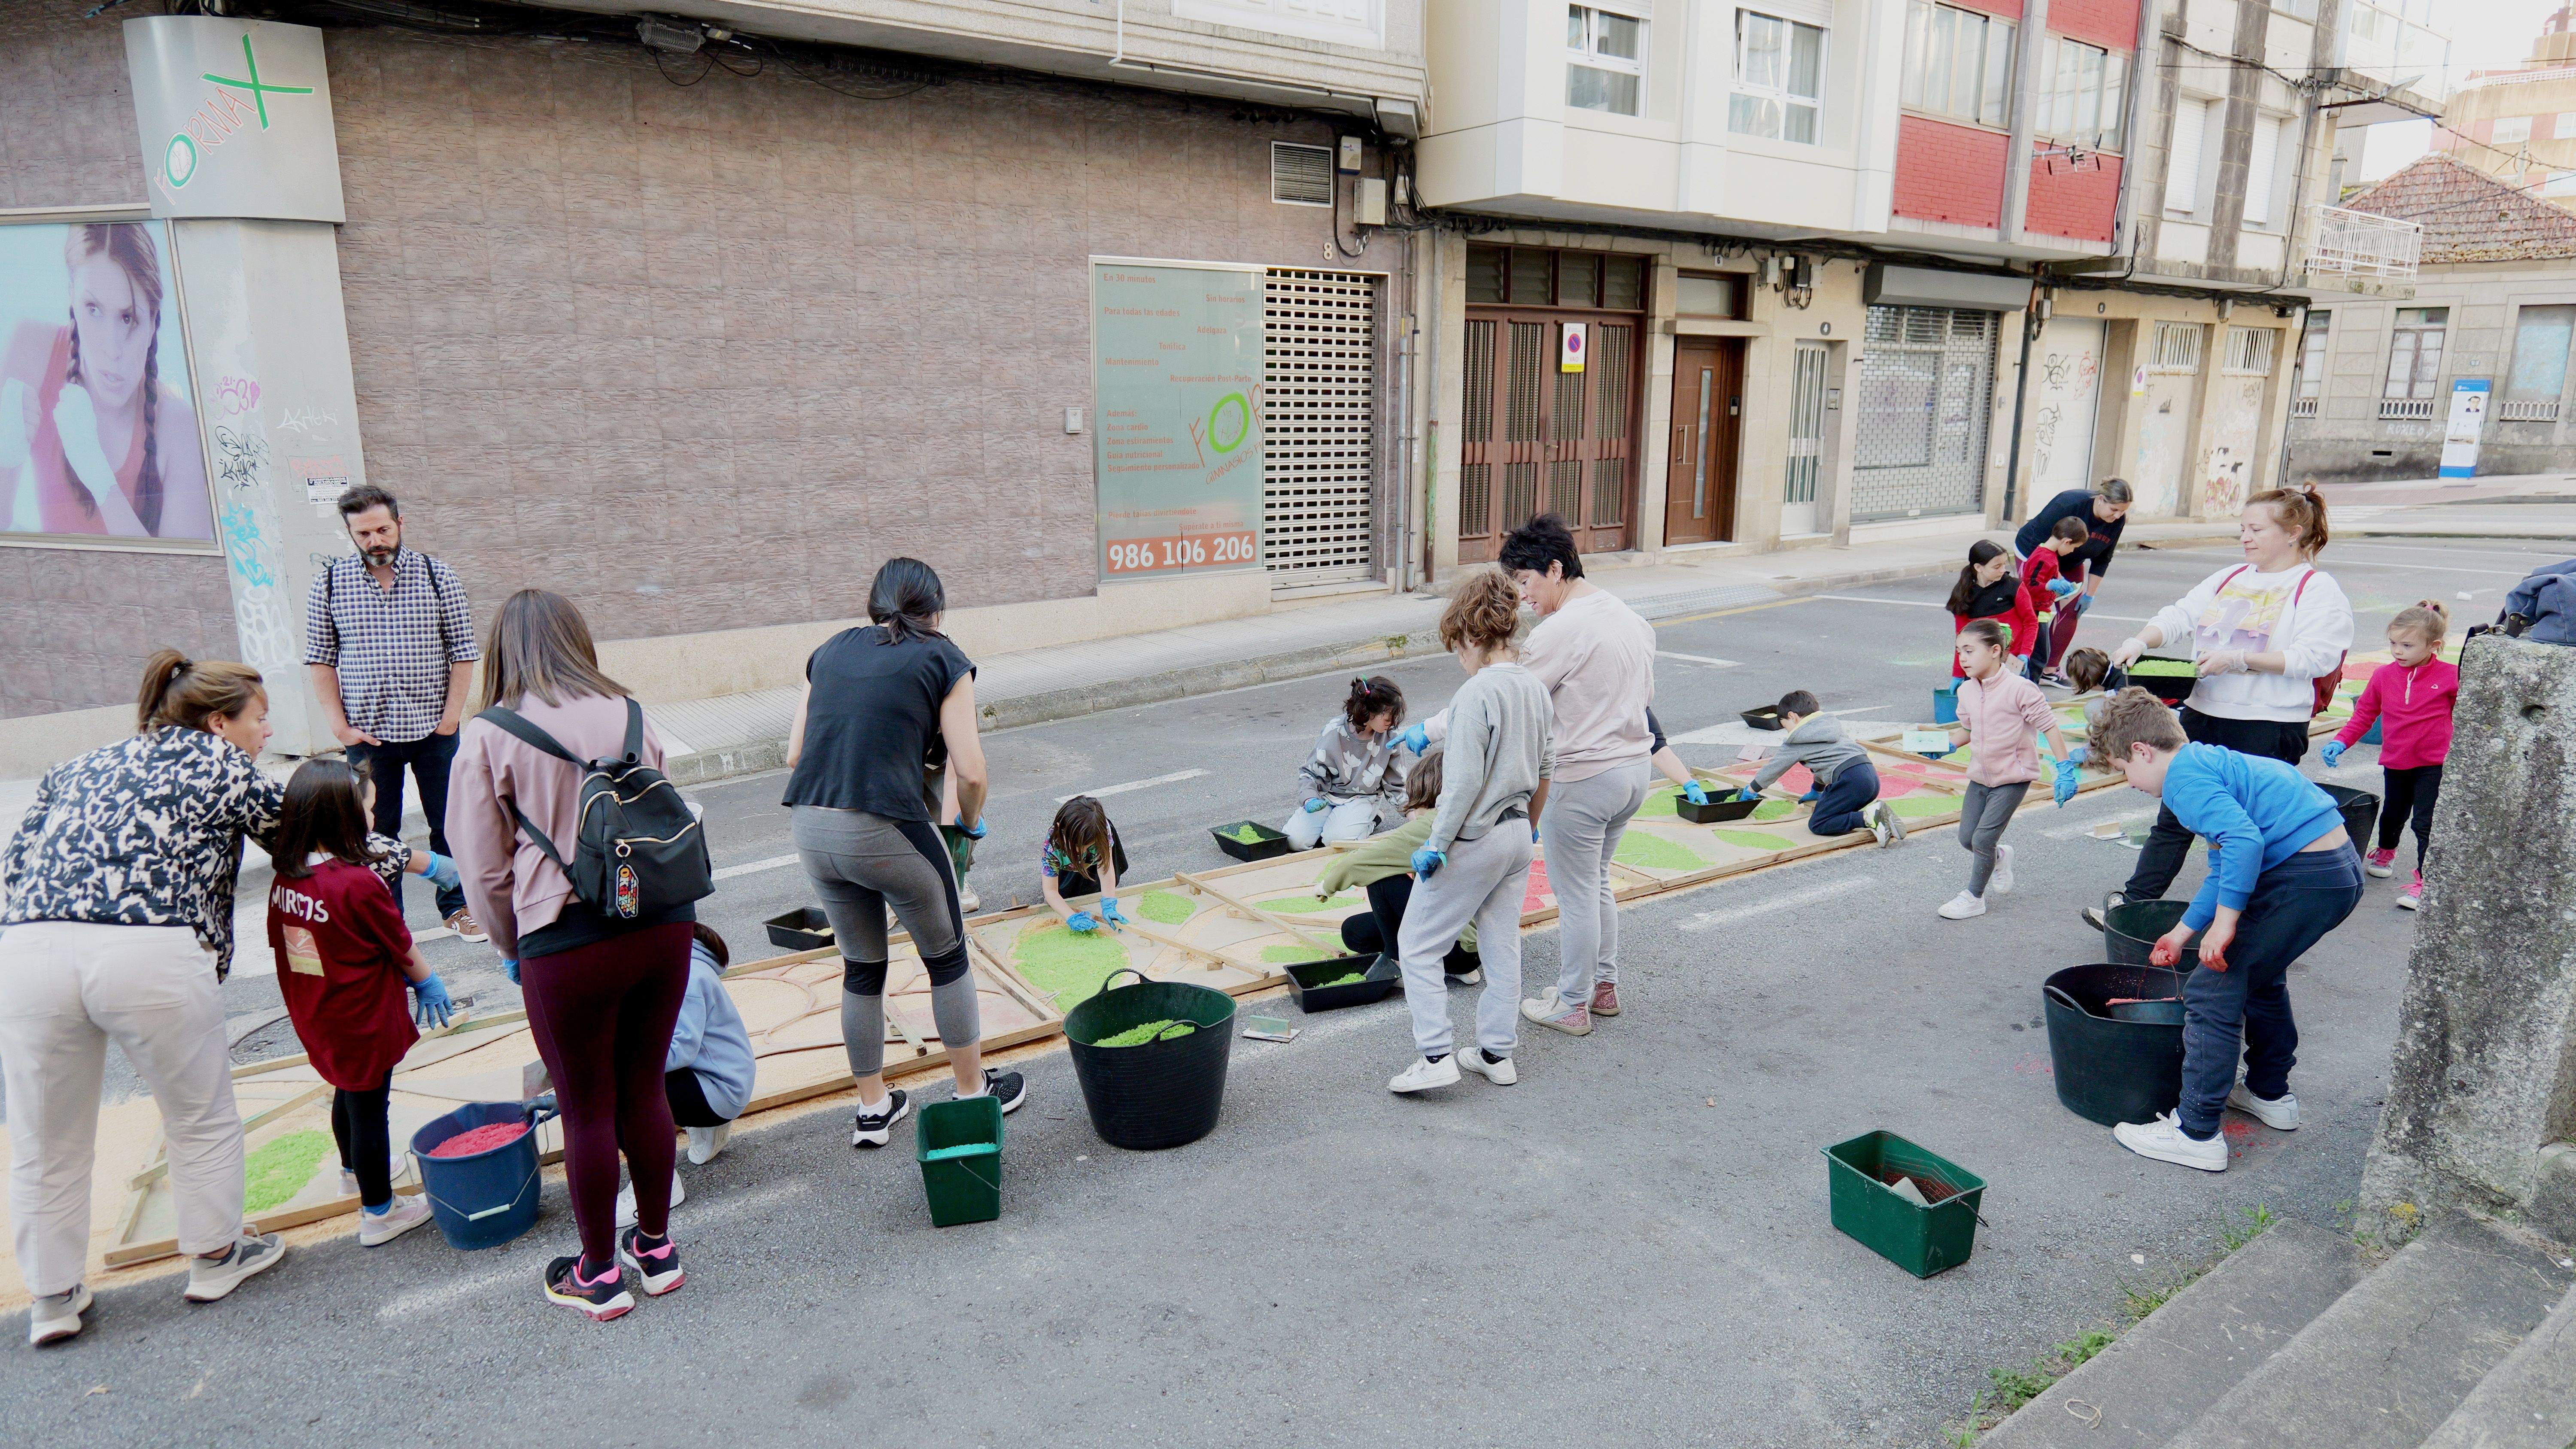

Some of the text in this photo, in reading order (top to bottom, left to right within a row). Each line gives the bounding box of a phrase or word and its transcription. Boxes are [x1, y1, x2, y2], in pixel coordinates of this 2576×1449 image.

[153, 31, 315, 206] FORMAX
[1324, 243, 1333, 260] 8
[1127, 275, 1156, 283] minutos
[1219, 295, 1245, 303] horarios
[1104, 307, 1120, 315] Para
[1156, 309, 1180, 317] edades
[1197, 326, 1227, 335] Adelgaza
[1159, 342, 1186, 350] Tonifica
[1106, 358, 1159, 366] Mantenimiento
[1170, 374, 1215, 383] Recuperación
[2386, 424, 2424, 437] ROMEO
[1107, 437, 1173, 445] Zona estiramientos
[1125, 450, 1163, 458] nutricional
[1108, 462, 1200, 473] Seguimiento personalizado
[1206, 447, 1253, 485] GIMNASIOS
[1109, 511, 1130, 519] Pierde
[1133, 510, 1151, 518] tallas
[1179, 522, 1208, 531] Supérate
[1109, 536, 1254, 570] 986 106 206
